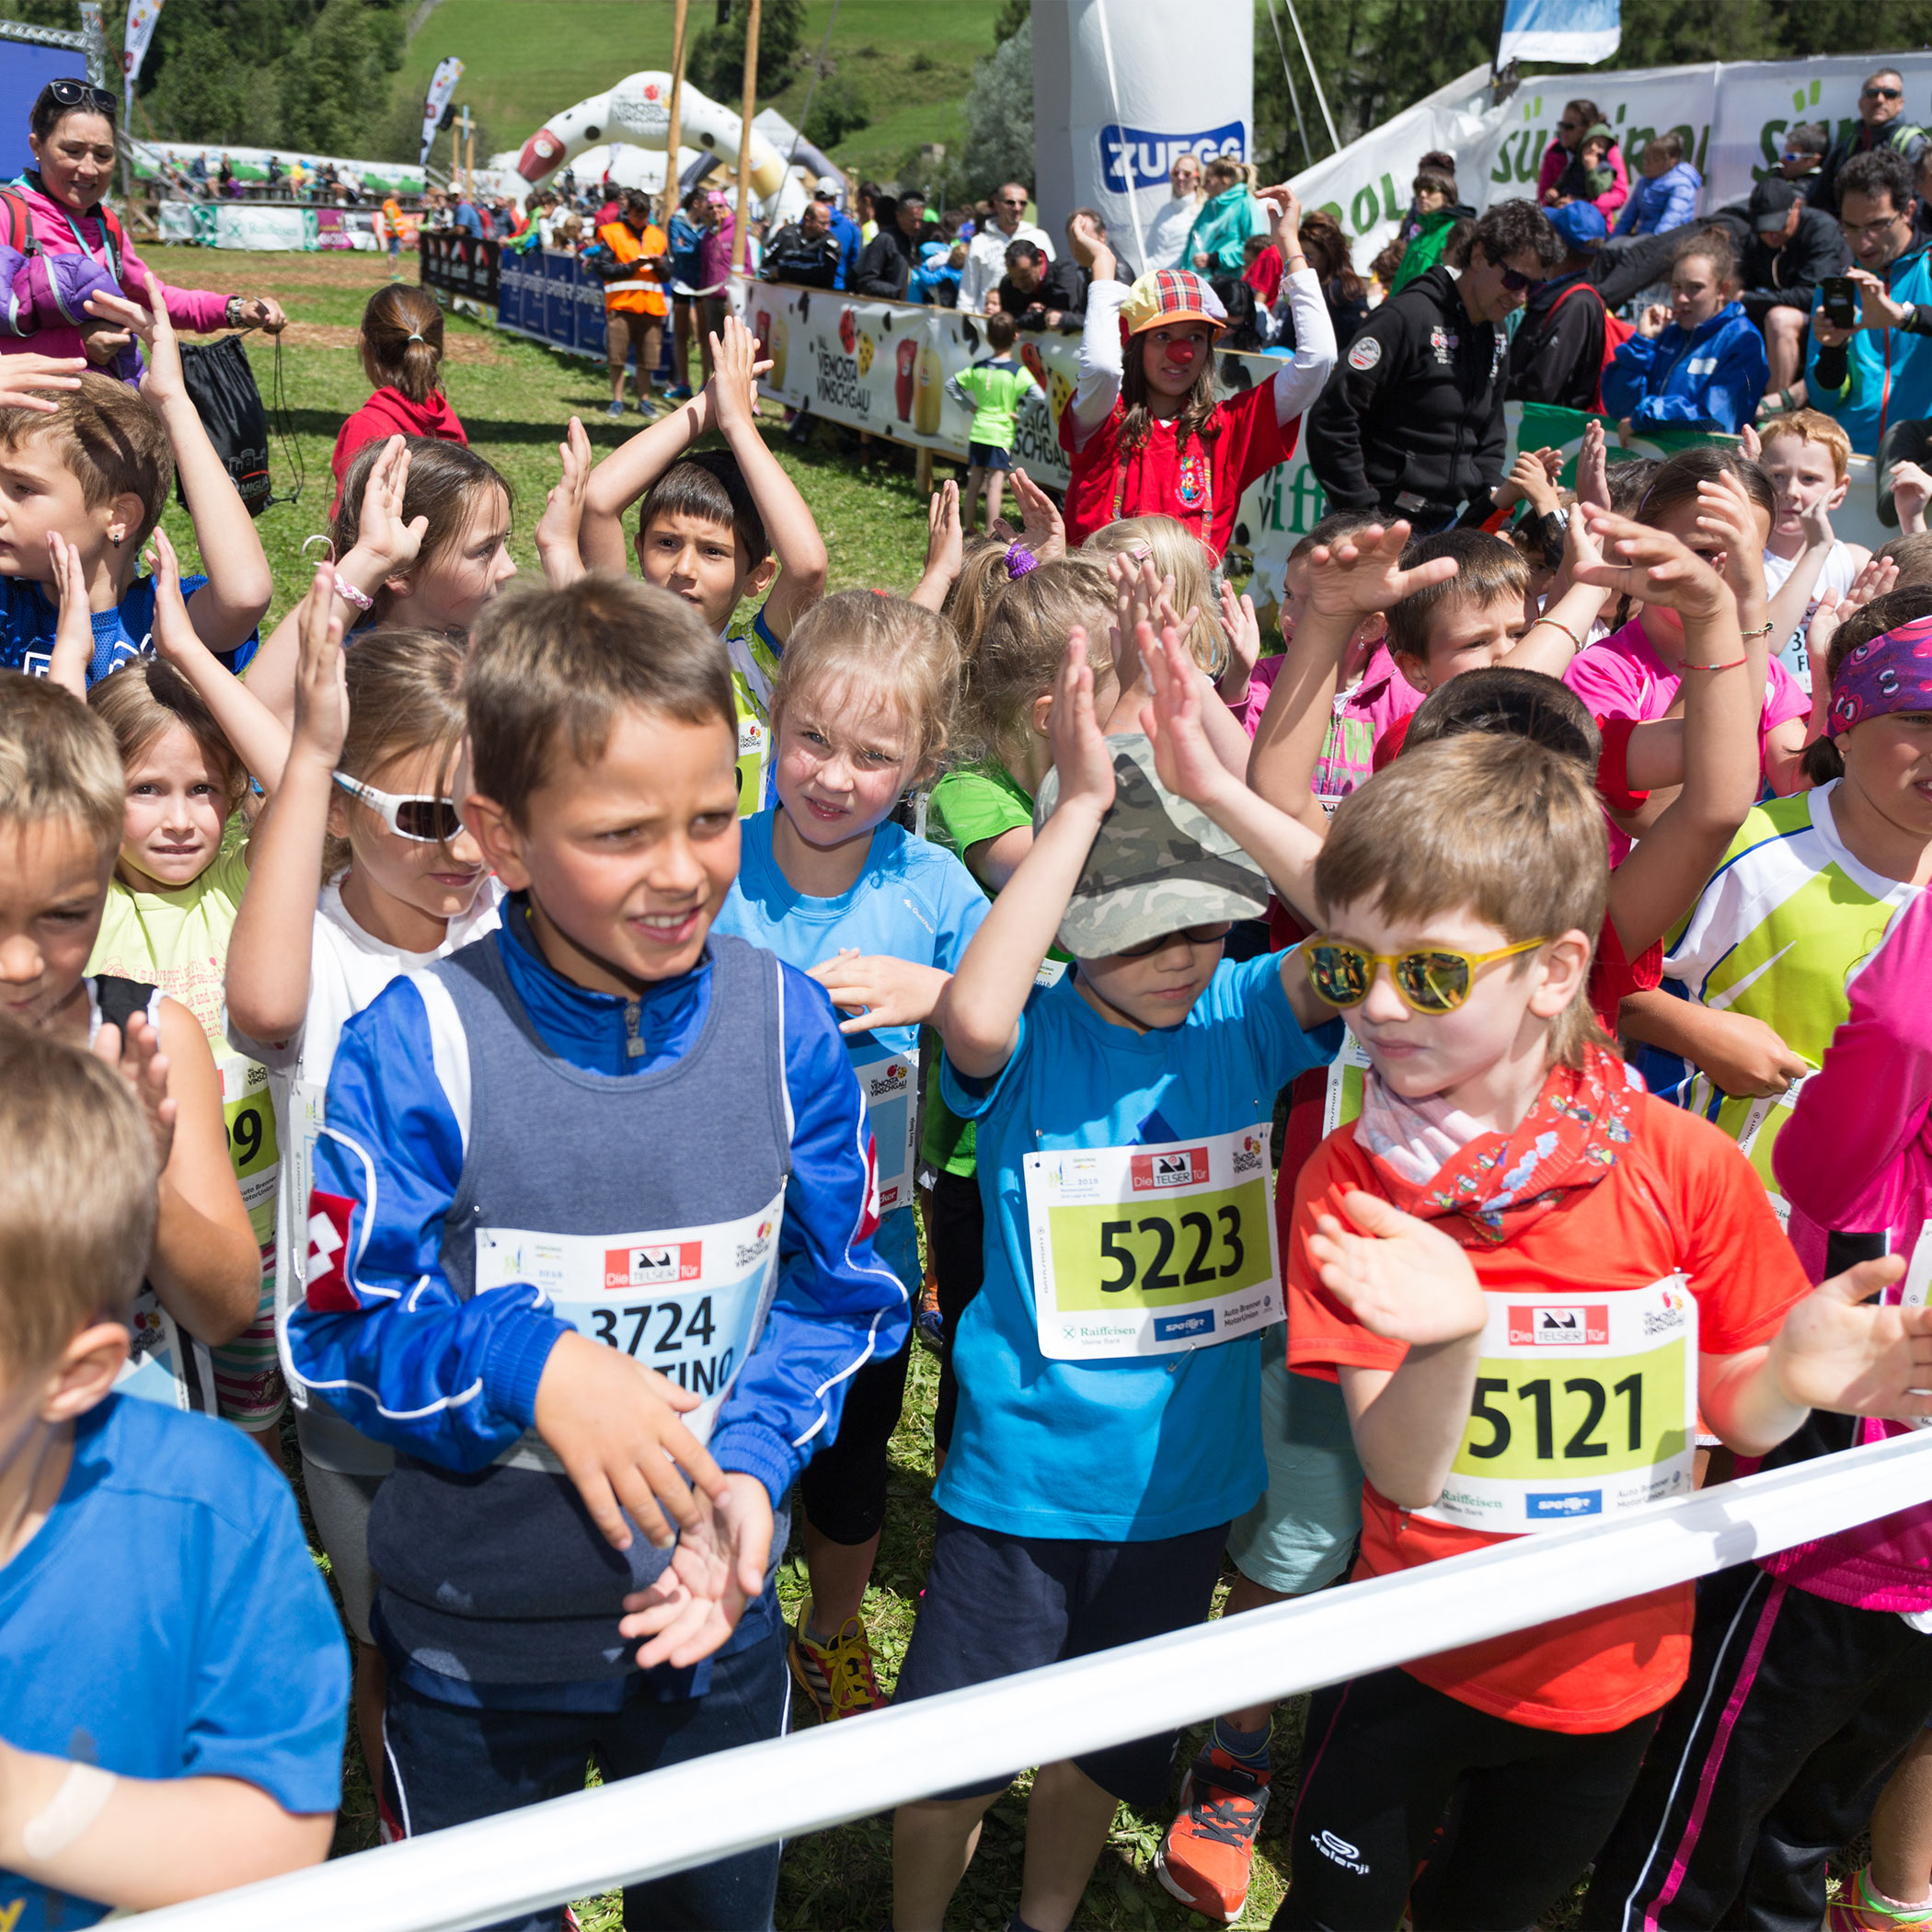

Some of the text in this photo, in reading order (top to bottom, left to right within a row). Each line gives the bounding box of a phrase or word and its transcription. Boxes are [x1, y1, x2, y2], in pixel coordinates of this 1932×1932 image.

[818, 352, 857, 385] VENOSTA
[816, 376, 870, 413] VINSCHGAU
[247, 1067, 267, 1078] VENO
[869, 1079, 907, 1098] VINSCHGAU
[870, 1076, 899, 1090] VENOSTA
[1156, 1171, 1190, 1184] TELSER
[1192, 1168, 1207, 1181] Tür
[1133, 1176, 1152, 1188] Die
[1100, 1204, 1245, 1293] 5223
[681, 1264, 699, 1277] Tür
[606, 1272, 628, 1286] Die
[592, 1295, 715, 1356] 3724
[1080, 1325, 1136, 1337] Raiffeisen
[1510, 1329, 1533, 1343] Die
[1538, 1328, 1583, 1341] TELSER
[1586, 1330, 1605, 1341] Tür
[1468, 1373, 1642, 1460] 5121
